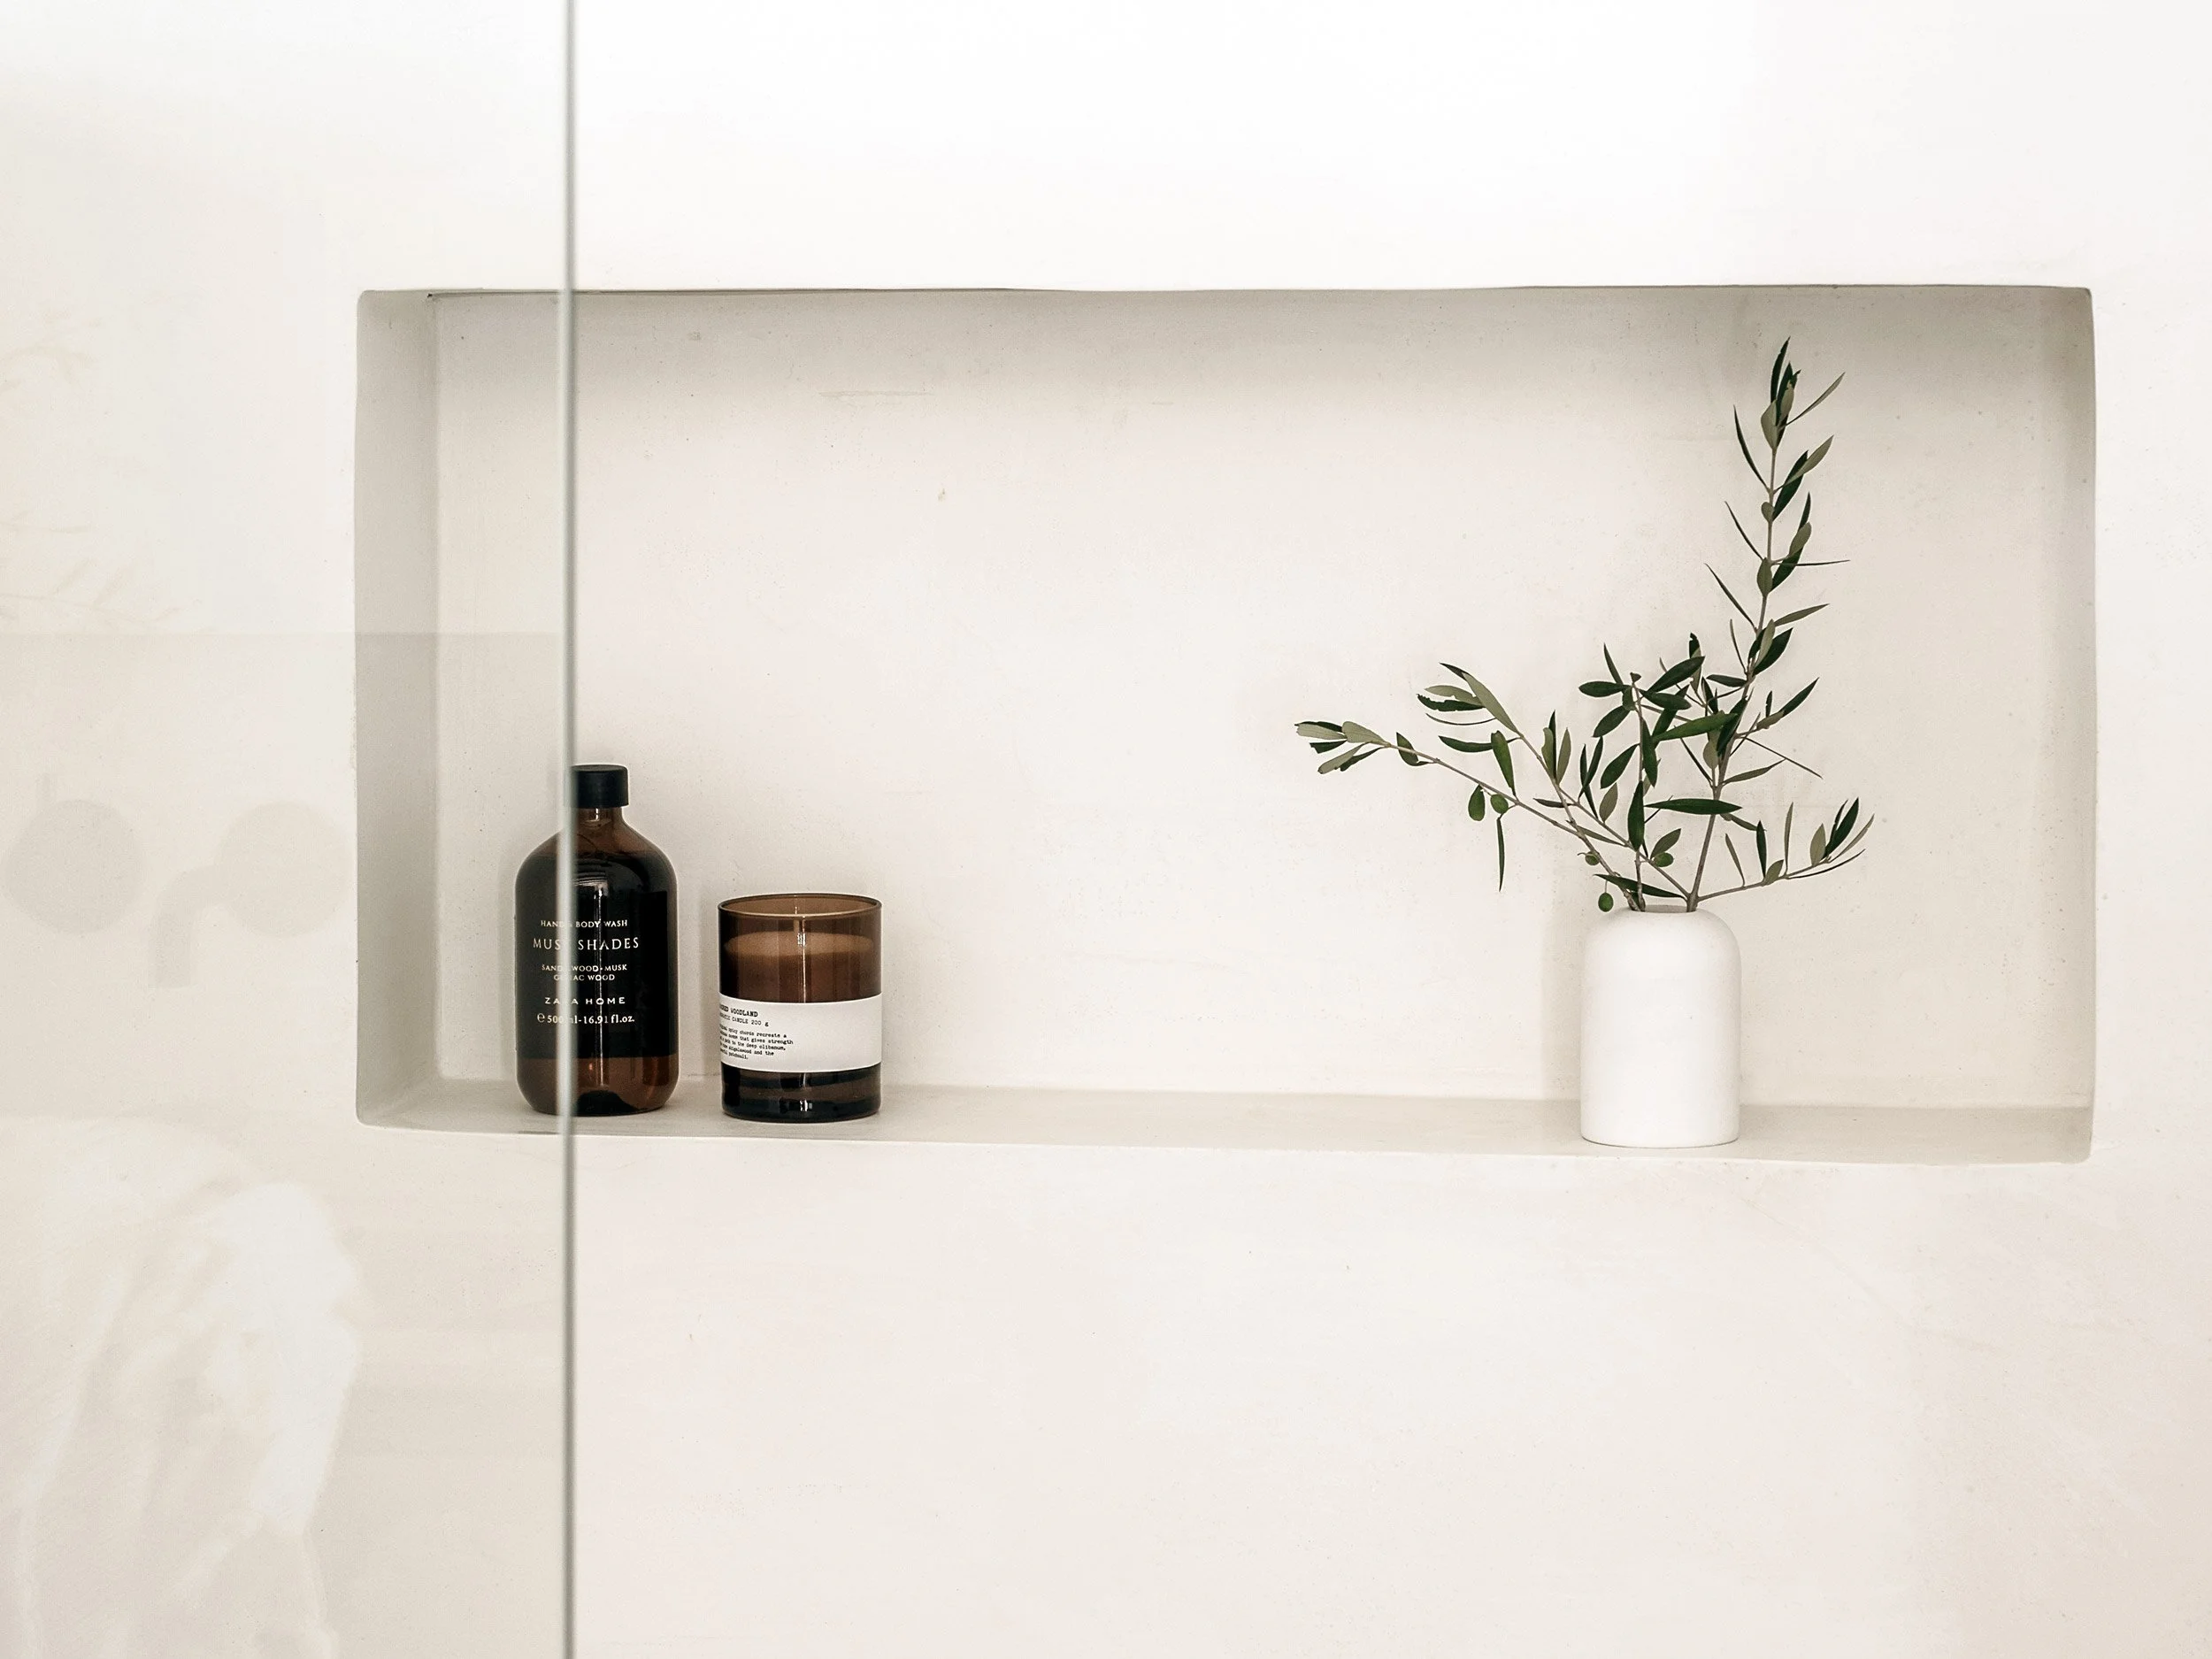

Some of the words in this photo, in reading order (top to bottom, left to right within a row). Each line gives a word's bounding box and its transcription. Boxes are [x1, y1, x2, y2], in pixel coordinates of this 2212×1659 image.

[533, 938, 561, 950] MUS
[578, 937, 639, 950] SHADES
[586, 996, 626, 1005] HOME
[730, 1008, 758, 1018] WOODLAND
